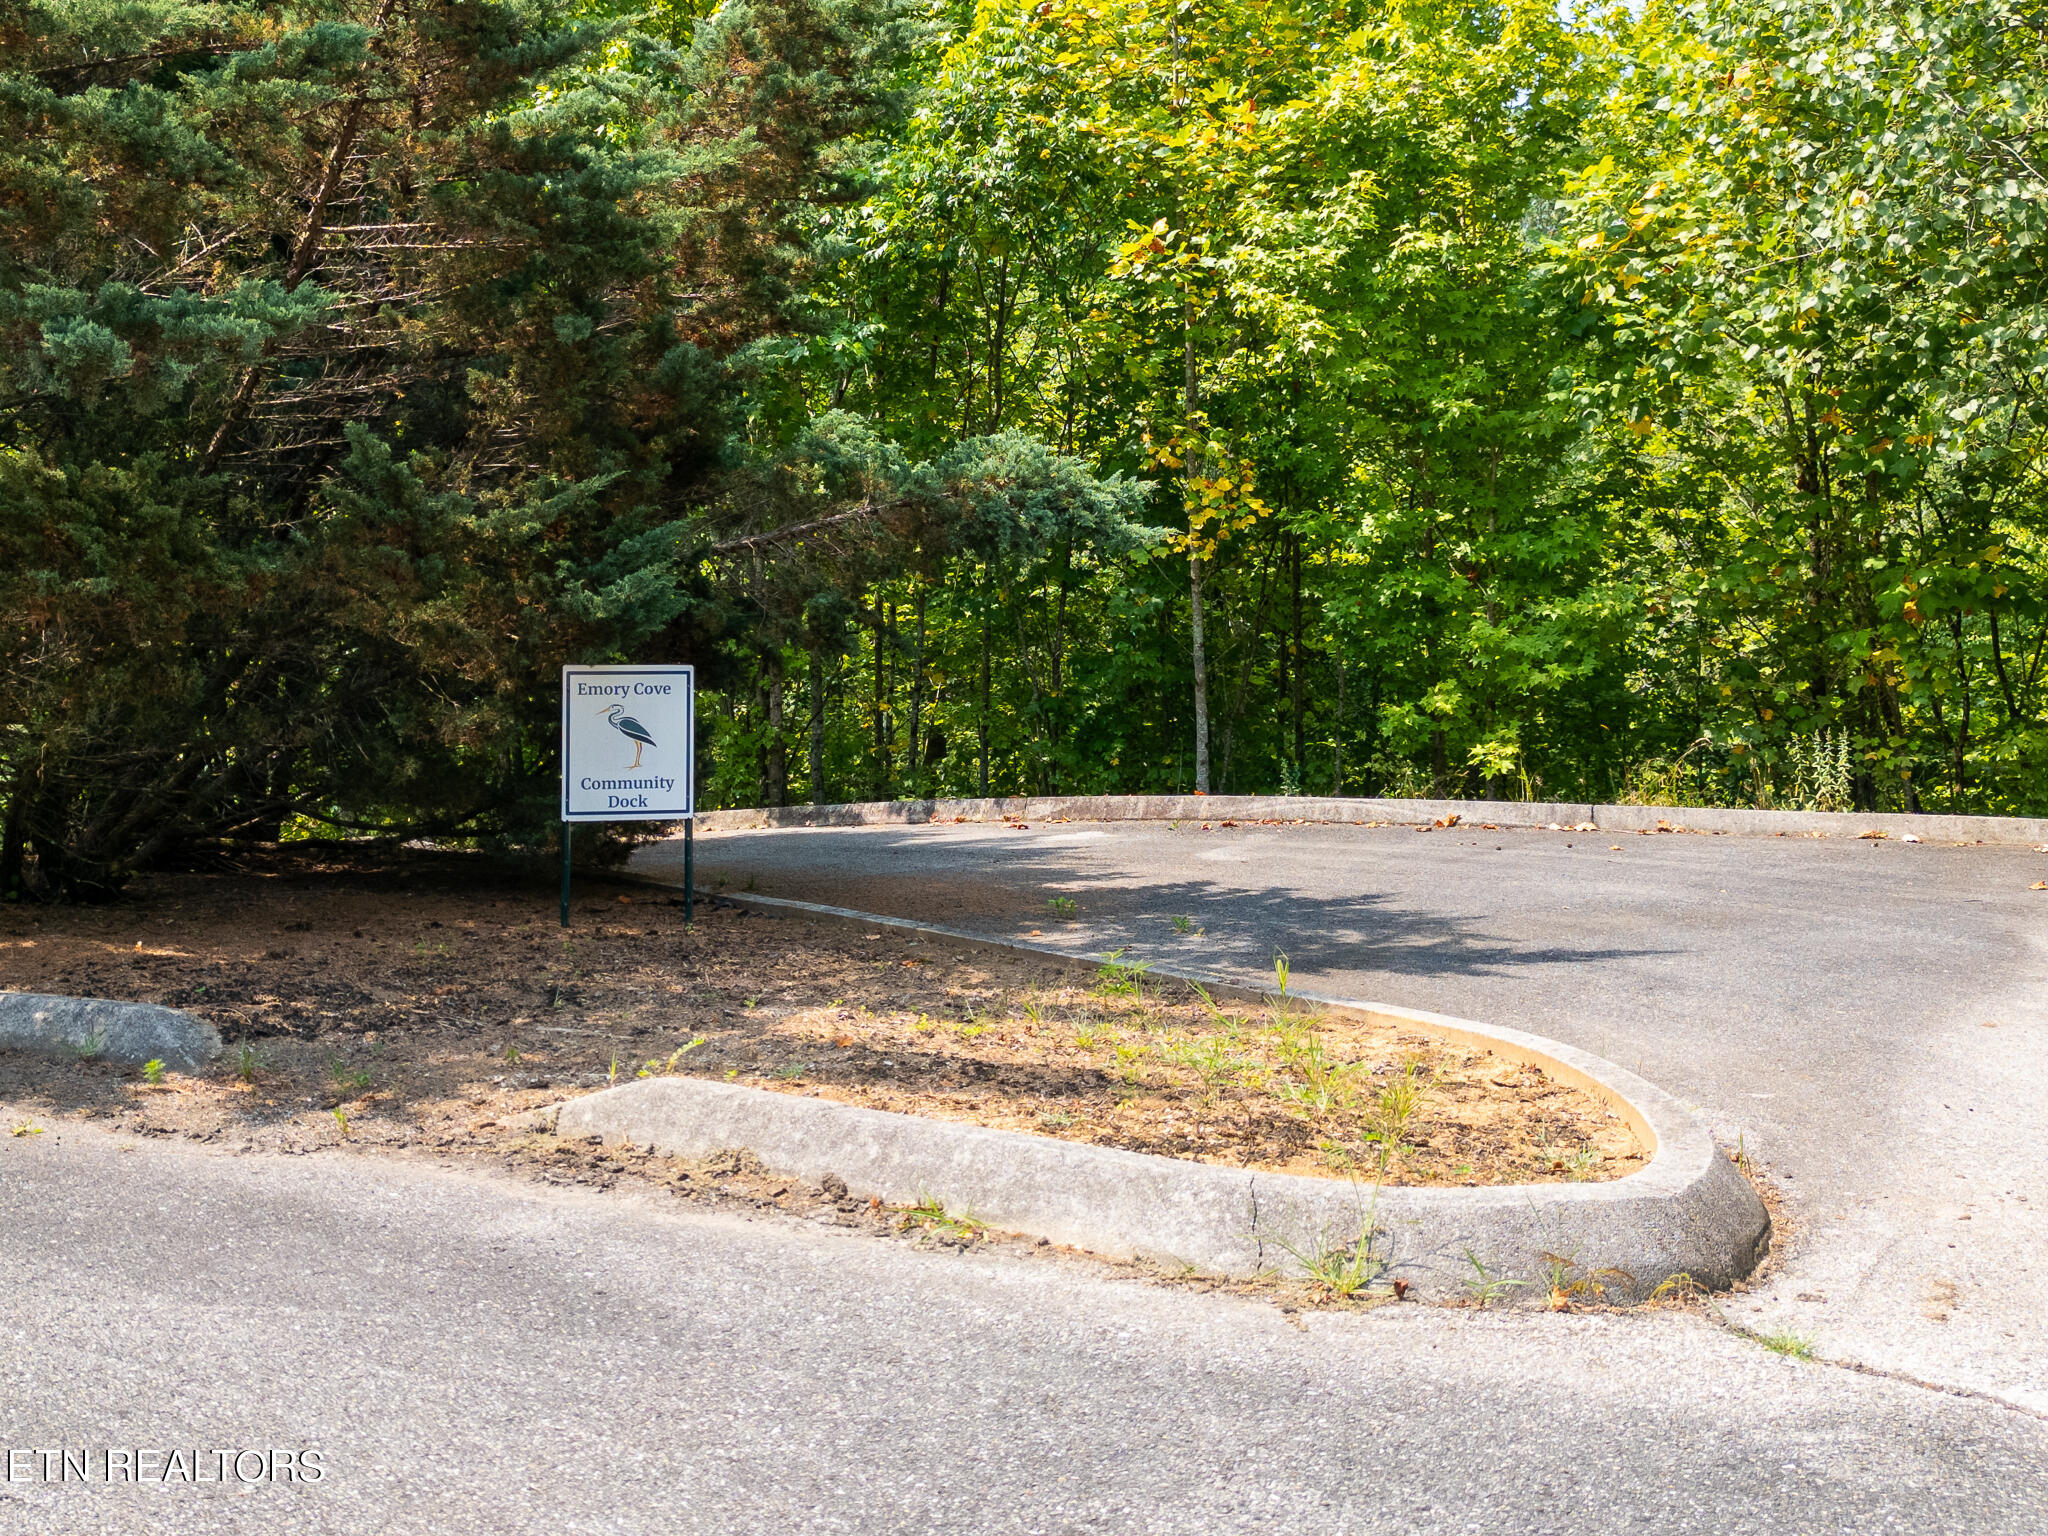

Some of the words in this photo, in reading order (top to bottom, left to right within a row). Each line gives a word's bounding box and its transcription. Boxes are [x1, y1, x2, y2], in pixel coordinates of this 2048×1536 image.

[577, 682, 631, 699] Emory
[633, 682, 672, 696] Cove
[580, 775, 675, 793] Community
[607, 794, 649, 808] Dock
